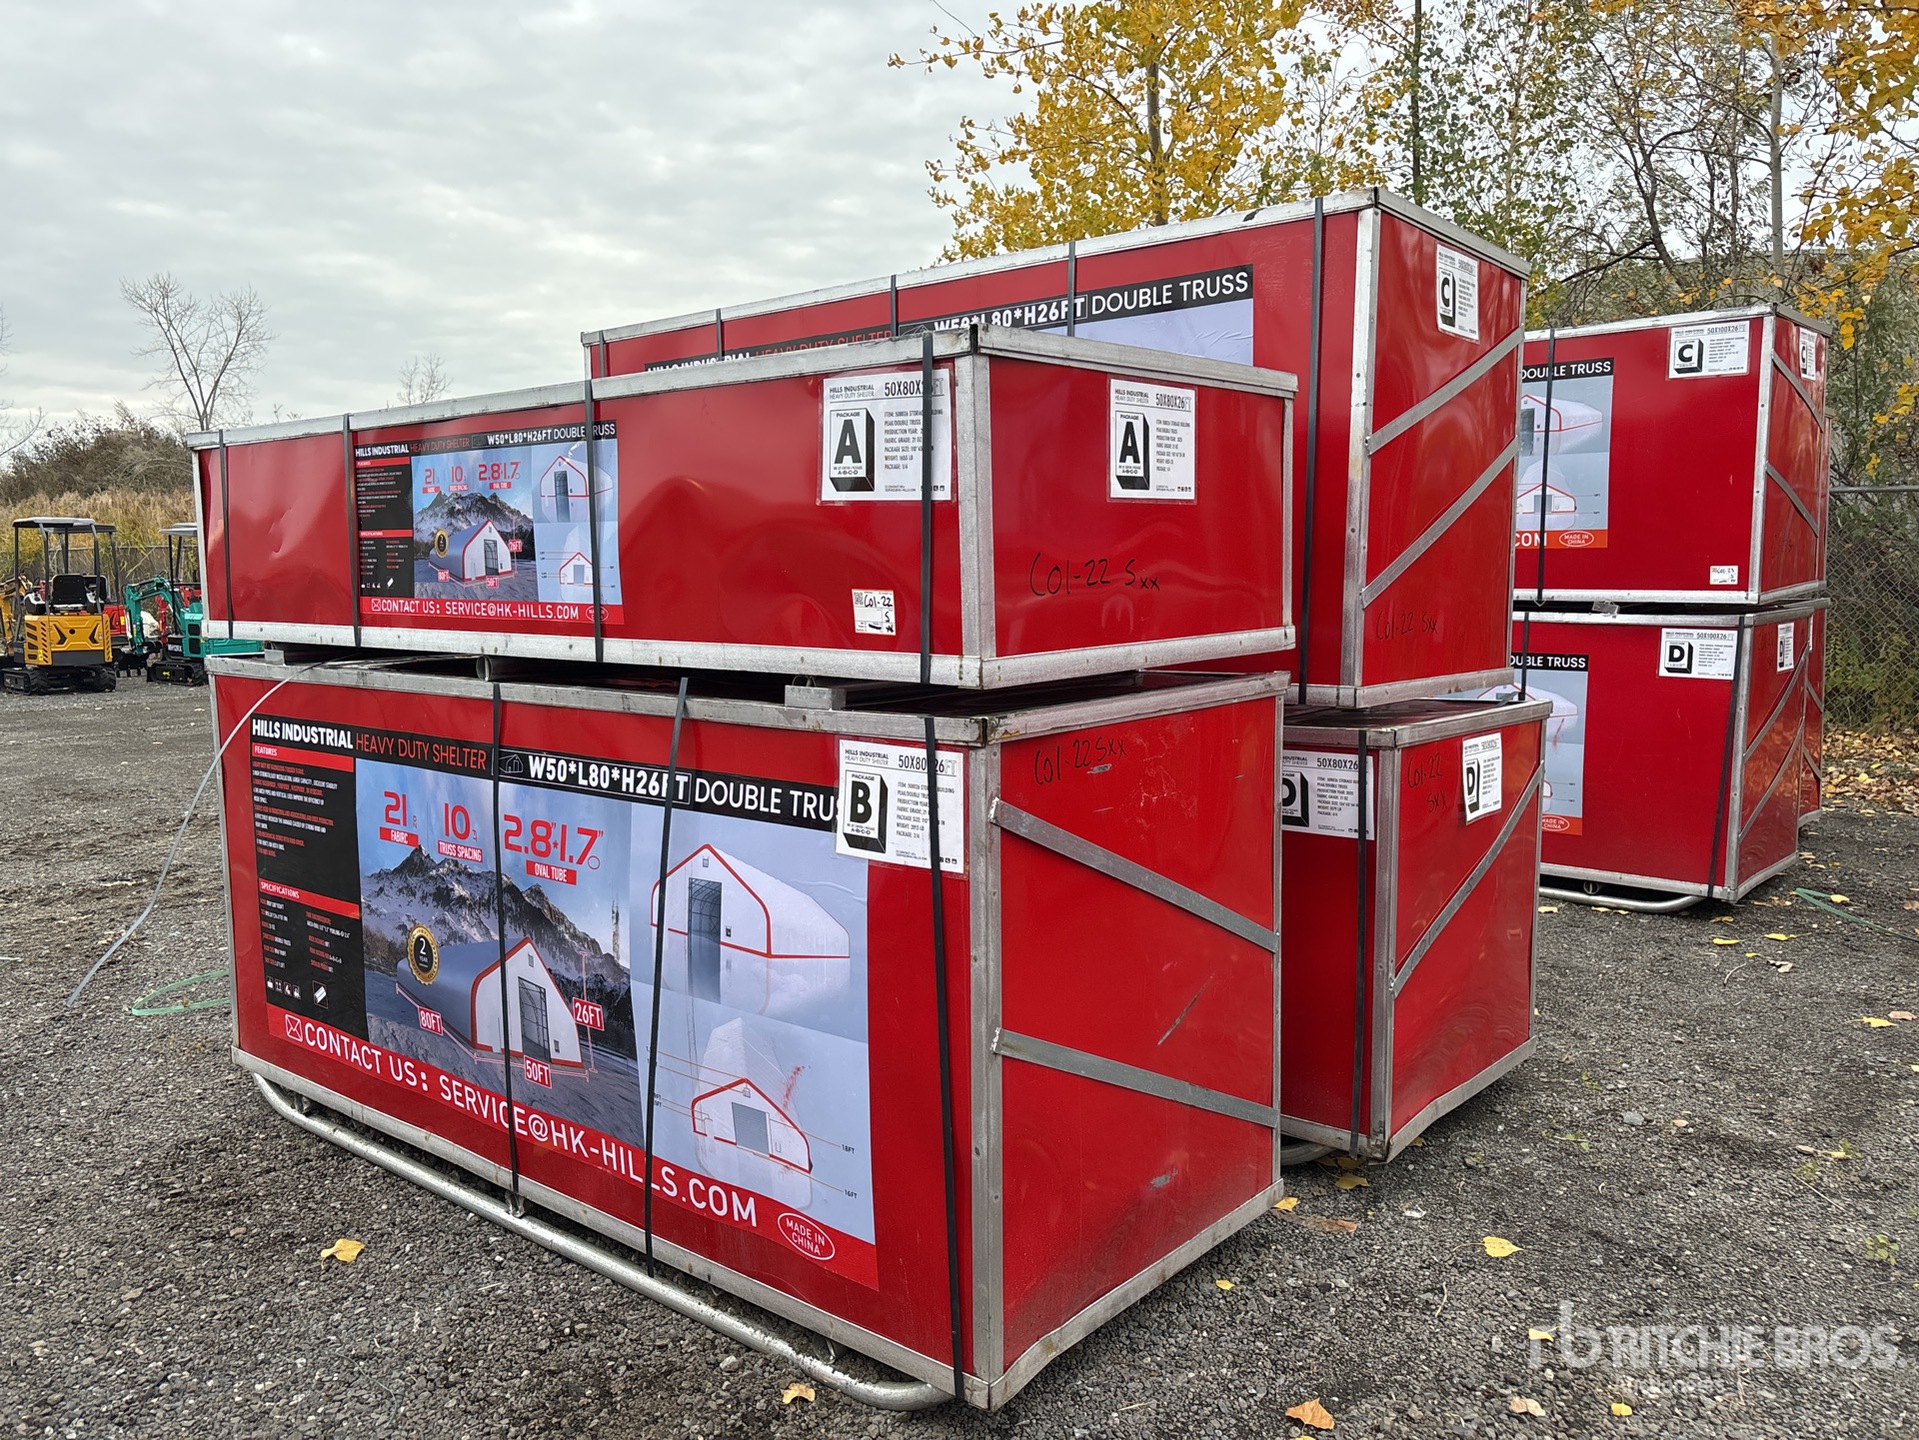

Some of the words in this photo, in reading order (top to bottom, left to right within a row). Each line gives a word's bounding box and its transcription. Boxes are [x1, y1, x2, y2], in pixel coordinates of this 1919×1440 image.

[1091, 284, 1172, 316] DOUBLE
[1179, 271, 1248, 301] TRUSS
[1441, 276, 1451, 308] C
[1678, 344, 1694, 362] C
[1570, 361, 1611, 376] TRUSS
[830, 386, 843, 394] HILLS
[844, 384, 874, 392] INDUSTRIAL
[884, 378, 944, 396] 50X80XFT
[355, 447, 371, 458] HILLS
[372, 444, 409, 455] INDUSTRIAL
[410, 441, 431, 452] HEAVY
[431, 440, 446, 451] DUTY
[447, 438, 470, 449] SHELTER
[553, 426, 586, 439] DOUBLE
[593, 423, 615, 436] RUSS
[834, 419, 862, 464] A
[1119, 421, 1140, 464] A
[425, 468, 435, 485] 21
[451, 466, 463, 482] 10
[381, 600, 420, 612] CONTACT
[422, 601, 440, 614] US:
[445, 602, 578, 620] SERVICE@HK-HILLS.COM
[1547, 657, 1586, 668] TRUSS
[1669, 645, 1685, 662] D
[254, 746, 278, 756] FEATURES
[859, 751, 889, 759] INDUSTRIAL
[252, 719, 281, 740] HILLS
[282, 722, 353, 749] INDUSTRIAL
[356, 734, 394, 756] HEAVY
[398, 738, 430, 762] DUTY
[433, 744, 487, 770] SHELTER
[694, 778, 782, 814] DOUBLE
[789, 790, 840, 822] TRU
[898, 754, 957, 775] 50X8026FT
[1466, 766, 1476, 796] D
[850, 780, 872, 824] B
[1282, 778, 1296, 807] D
[384, 791, 407, 827] 21
[444, 803, 470, 840] 10
[439, 841, 456, 857] TRUSS
[457, 845, 482, 862] SPACING
[534, 863, 550, 879] OVAL
[551, 866, 567, 883] TUBE
[261, 882, 300, 899] SPECIFICATIONS
[420, 938, 426, 955] 2
[420, 1010, 441, 1032] 80FT
[574, 1002, 602, 1028] 26FT
[304, 1022, 382, 1074] CONTACT
[389, 1055, 428, 1092] US:
[526, 1059, 550, 1086] 50FT
[786, 1218, 812, 1240] MADE
[815, 1233, 825, 1246] IN
[792, 1232, 820, 1256] CHINA
